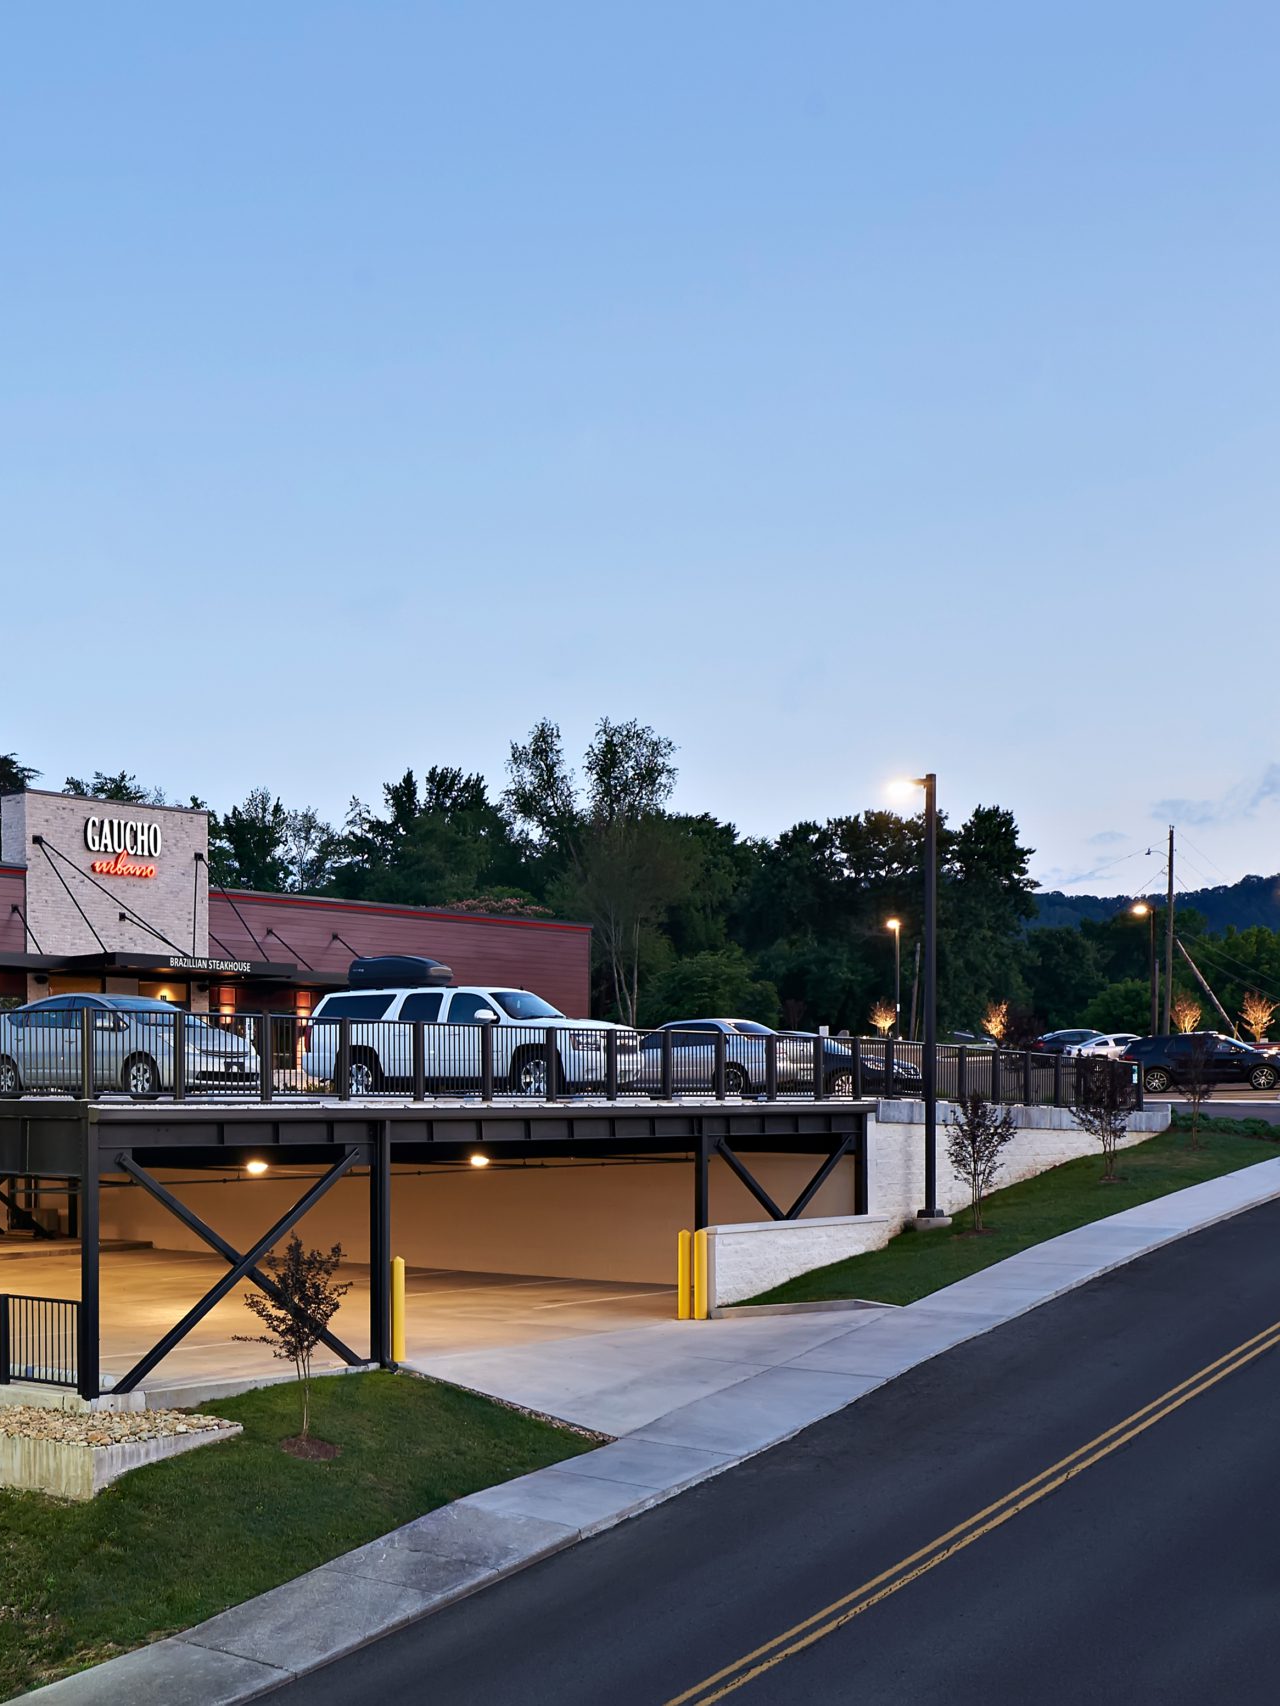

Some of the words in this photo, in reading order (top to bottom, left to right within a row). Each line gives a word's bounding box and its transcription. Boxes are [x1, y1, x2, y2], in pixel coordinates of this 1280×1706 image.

[87, 816, 161, 857] GAUCHO
[93, 849, 156, 878] urbano
[208, 960, 251, 972] STEAKHOUSE
